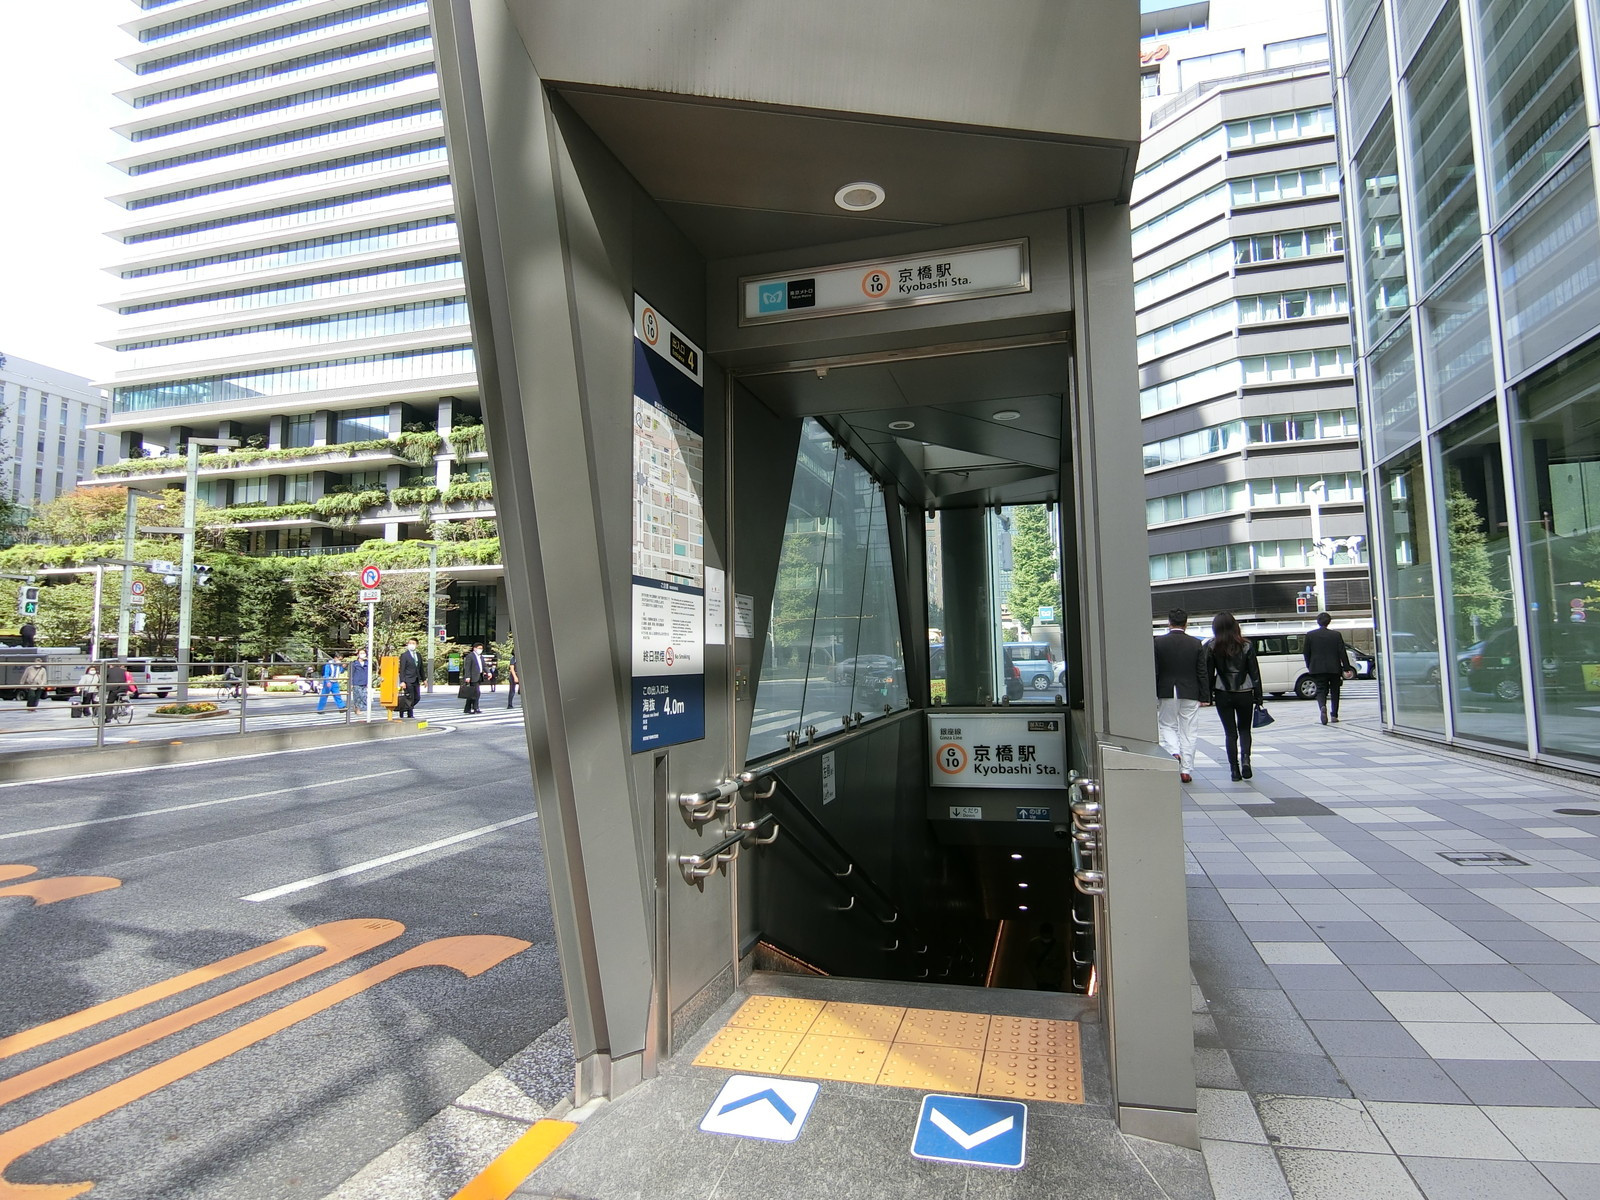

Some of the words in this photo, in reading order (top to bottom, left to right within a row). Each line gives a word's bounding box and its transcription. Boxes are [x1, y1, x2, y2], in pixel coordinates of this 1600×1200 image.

[872, 274, 880, 282] G
[898, 262, 952, 283] 京橋駅
[870, 283, 883, 292] 10
[898, 278, 948, 294] Kyobashi
[951, 277, 972, 287] Sta.
[648, 314, 653, 324] G
[647, 324, 655, 338] 10
[687, 350, 694, 370] 4
[642, 685, 669, 696] この出入口は
[642, 698, 656, 712] 海抜
[663, 696, 685, 715] 4.0m
[940, 727, 962, 736] 銀座線
[1047, 721, 1054, 731] 4
[947, 748, 956, 757] G
[973, 744, 1036, 763] 京橋駅
[945, 758, 960, 768] 10
[974, 763, 1032, 777] Kyobashi
[1036, 764, 1060, 775] Sta.
